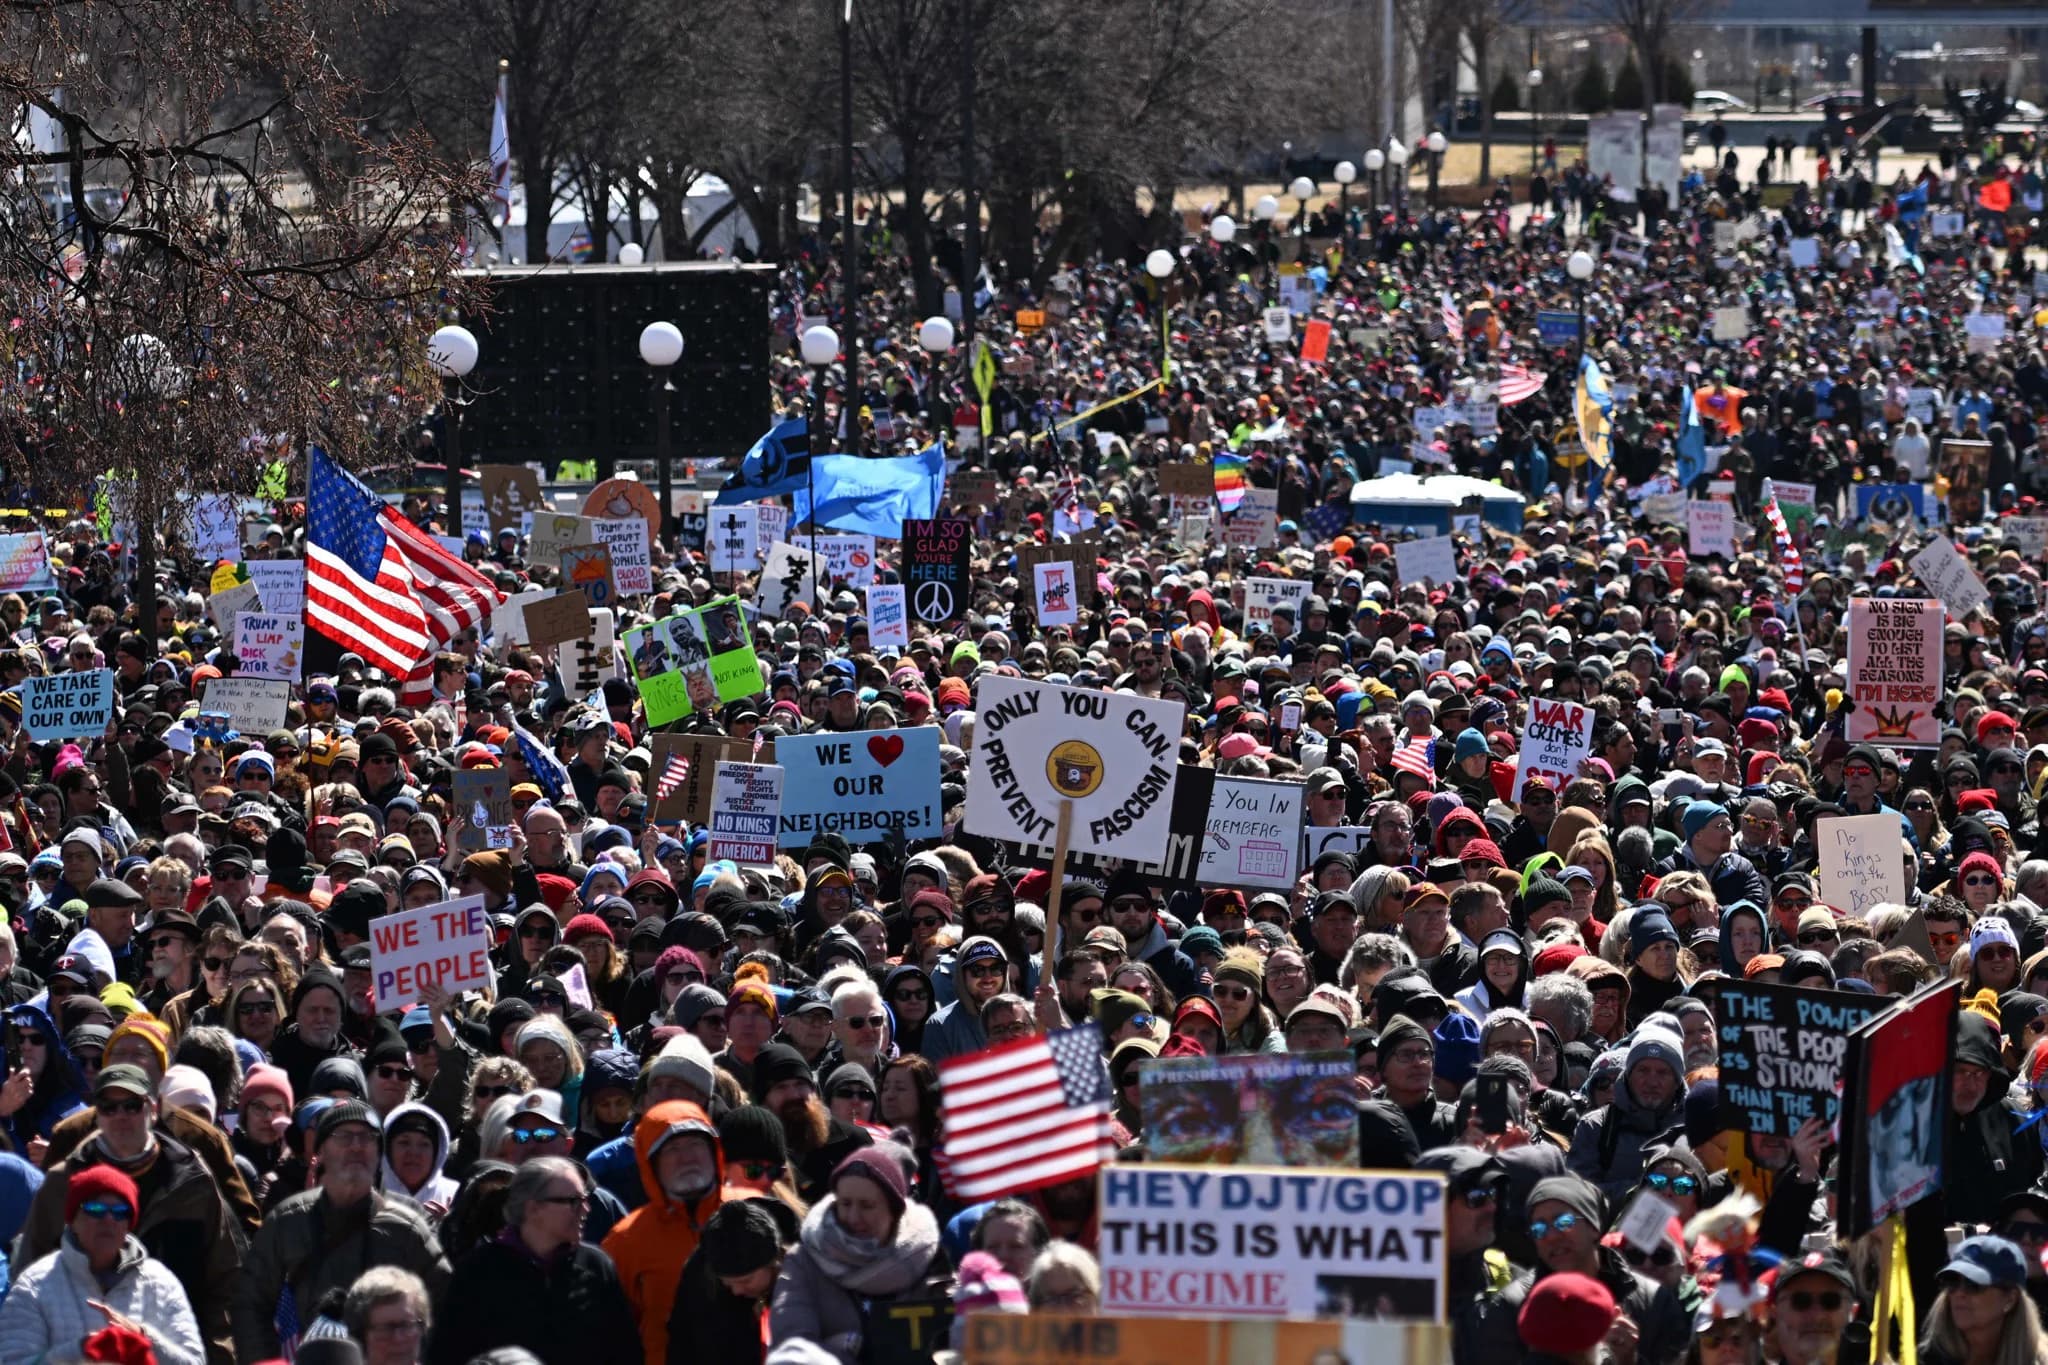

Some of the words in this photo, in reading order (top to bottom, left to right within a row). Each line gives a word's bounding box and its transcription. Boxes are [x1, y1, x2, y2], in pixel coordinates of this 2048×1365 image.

[907, 521, 934, 538] I'M
[940, 522, 964, 538] SO
[611, 543, 640, 553] ACIST
[916, 539, 959, 552] GLAD
[617, 569, 646, 580] BLOOD
[911, 565, 958, 581] HERE
[620, 580, 649, 590] HANDS
[1042, 582, 1070, 604] KINGS
[1281, 585, 1302, 597] NOT
[1869, 601, 1888, 614] NO
[1892, 601, 1923, 614] SIGN
[241, 616, 279, 631] TRUMP
[286, 621, 297, 632] IS
[1877, 615, 1889, 627] IS
[1893, 615, 1916, 628] BIG
[241, 633, 249, 645] A
[256, 633, 284, 645] LIMP
[1867, 629, 1924, 642] ENOUGH
[241, 647, 266, 659] DICK
[1868, 642, 1888, 656] TO
[1890, 642, 1923, 655] LIST
[1866, 656, 1893, 668] ALL
[1896, 656, 1925, 668] THE
[732, 664, 756, 680] KING
[1859, 670, 1925, 683] REASONS
[60, 674, 101, 692] TAKE
[32, 694, 75, 710] CARE
[80, 691, 101, 707] OF
[1855, 684, 1882, 701] I'M
[1886, 685, 1936, 704] HERE
[29, 712, 64, 728] OUR
[984, 689, 1041, 732] ONLY
[1061, 691, 1108, 720] YOU
[1125, 709, 1172, 758] CAN
[1533, 699, 1585, 732] WAR
[1528, 722, 1584, 748] CRIMES
[815, 744, 852, 766] WE
[1544, 743, 1569, 757] don't
[728, 765, 763, 773] COURAGE
[1539, 754, 1569, 768] erase
[734, 778, 774, 786] DIVERSITY
[746, 785, 774, 793] RIGHTS
[833, 775, 884, 797] OUR
[741, 792, 780, 800] KINDNESS
[980, 738, 1055, 841] PREVENT
[1090, 764, 1172, 845] FASCISM
[724, 797, 755, 805] JUSTICE
[729, 804, 766, 812] EQUALITY
[1225, 789, 1259, 812] You
[716, 815, 733, 831] NO
[735, 816, 770, 833] KINGS
[780, 806, 931, 834] NEIGHBORS!
[715, 843, 767, 861] AMERICA
[373, 919, 419, 955] WE
[430, 906, 484, 942] THE
[377, 949, 486, 1001] PEOPLE
[1721, 992, 1774, 1021] THE
[1721, 1026, 1742, 1043] OF
[1744, 1025, 1790, 1055] THE
[1798, 1030, 1848, 1066] PEOP
[1296, 1063, 1315, 1075] OF
[1319, 1062, 1353, 1075] LIES
[1721, 1052, 1749, 1071] IS
[1725, 1085, 1774, 1109] THAN
[1776, 1092, 1816, 1117] THE
[1747, 1112, 1776, 1133] IN
[1105, 1172, 1210, 1209] HEY
[1219, 1175, 1442, 1216] DJT/GOP
[1102, 1221, 1218, 1257] THIS
[1233, 1224, 1280, 1258] IS
[1293, 1226, 1443, 1264] WHAT
[1107, 1268, 1290, 1308] REGIME
[974, 1320, 1120, 1356] DUMB
